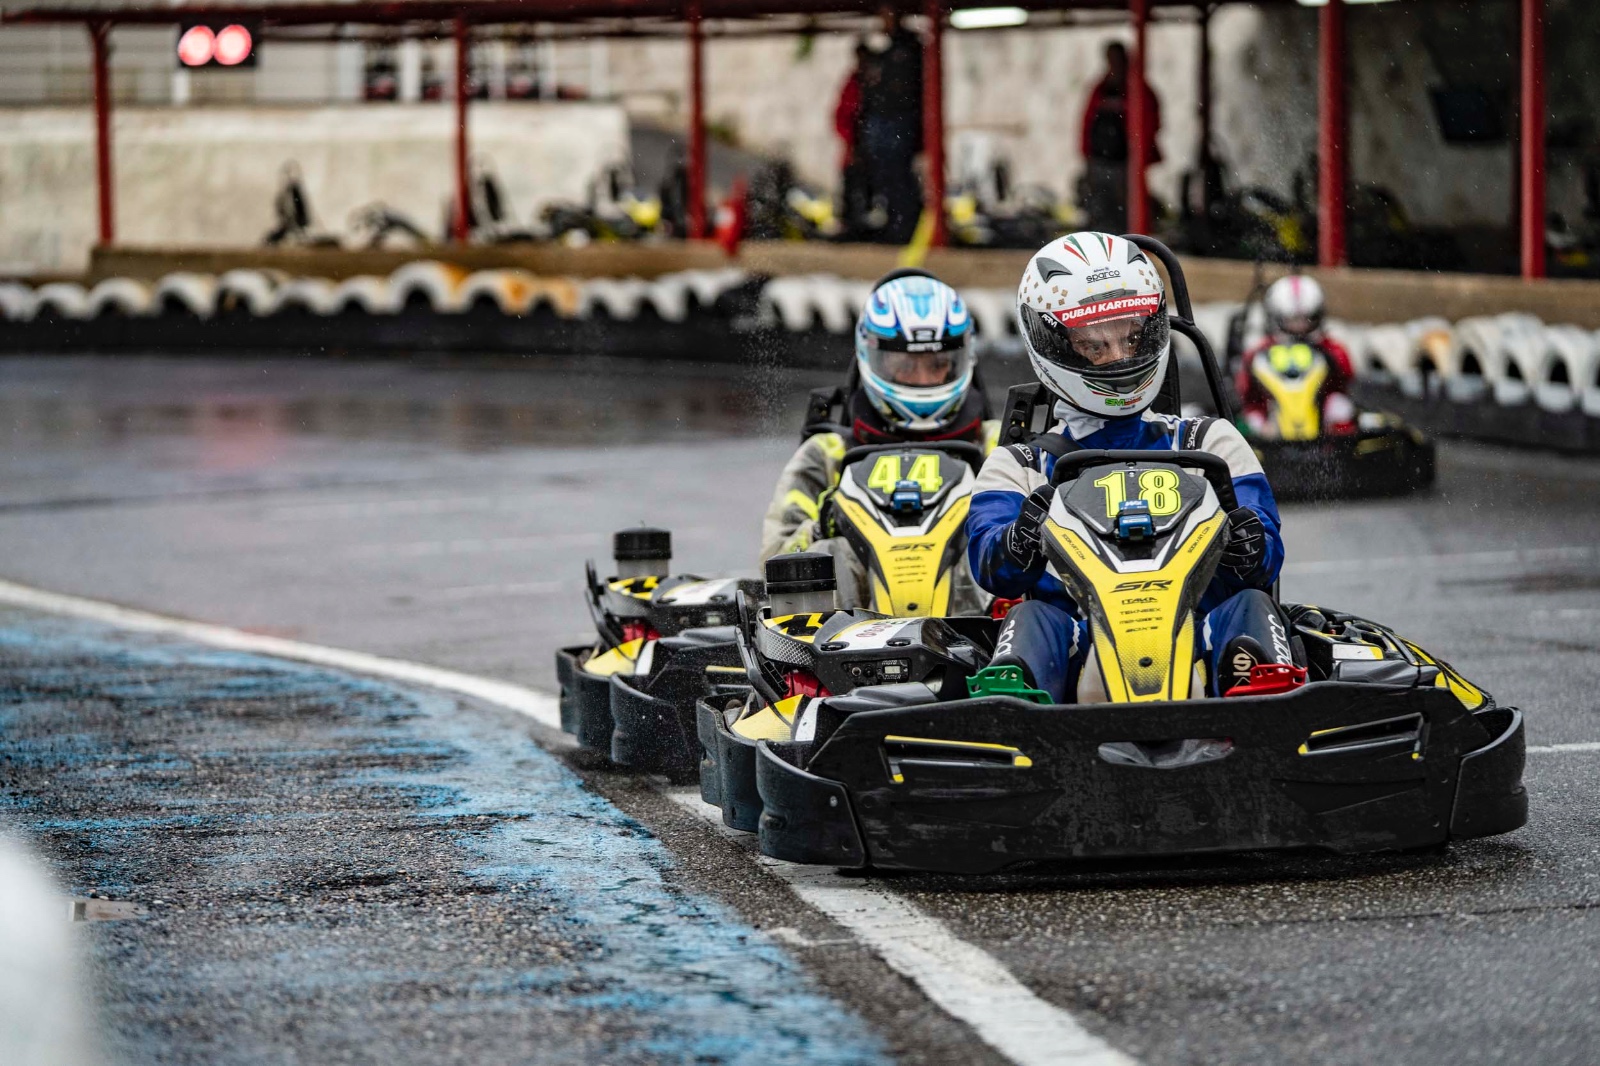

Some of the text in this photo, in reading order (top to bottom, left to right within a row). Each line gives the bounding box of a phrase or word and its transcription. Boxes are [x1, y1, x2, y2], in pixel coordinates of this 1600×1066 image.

[1086, 270, 1120, 283] sparco
[1061, 297, 1158, 321] DUBAI KARTDROME
[868, 454, 943, 494] 44
[1094, 468, 1181, 518] 18
[887, 542, 936, 553] SR
[1109, 580, 1174, 593] SR
